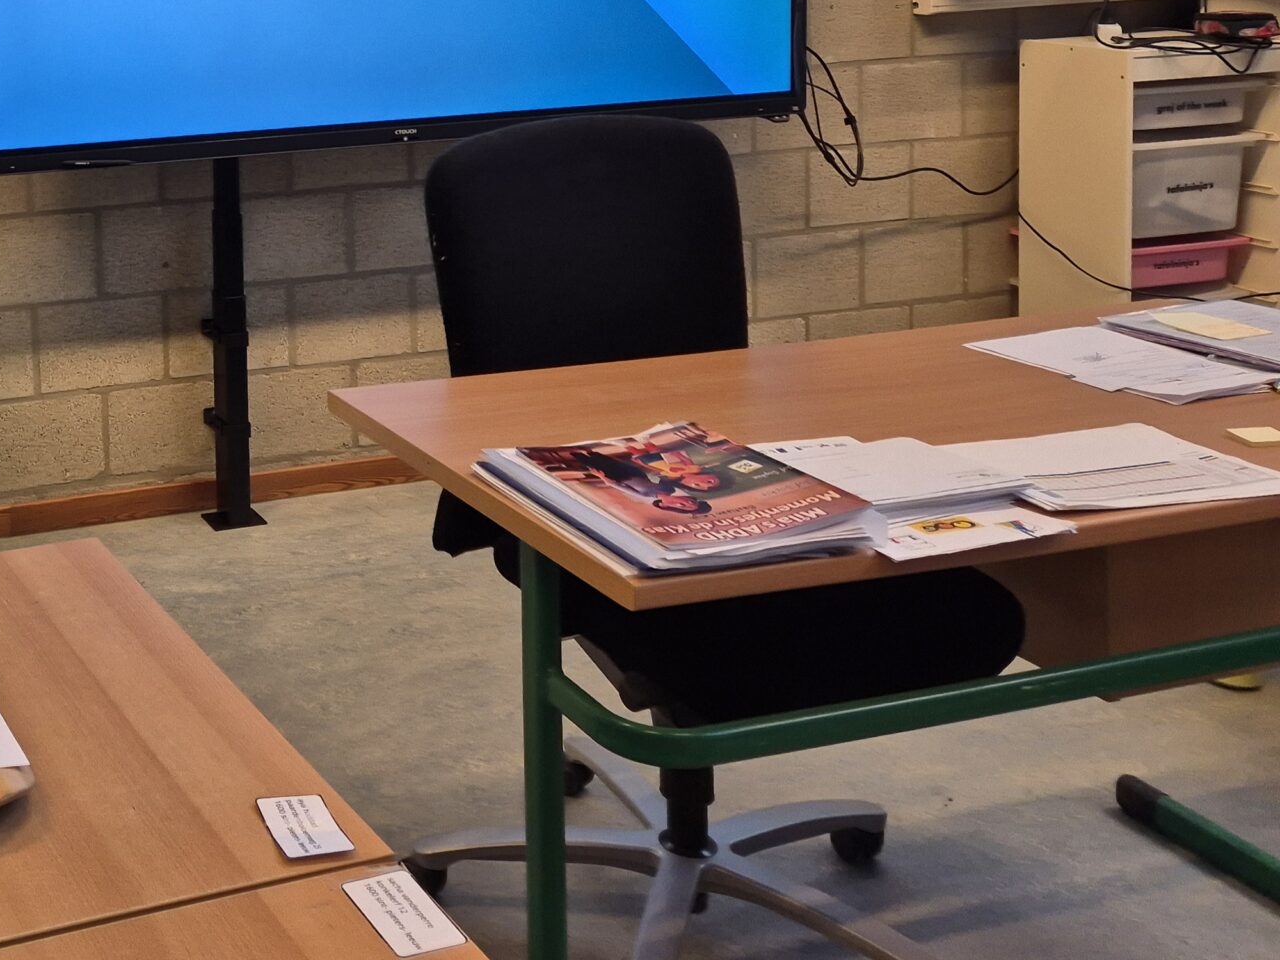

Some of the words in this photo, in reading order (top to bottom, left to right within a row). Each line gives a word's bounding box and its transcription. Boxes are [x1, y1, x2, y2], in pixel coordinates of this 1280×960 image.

[735, 490, 842, 523] Momentjes
[714, 518, 736, 527] in
[762, 506, 828, 530] Mila's
[641, 524, 686, 535] Klas
[688, 521, 713, 531] de
[694, 524, 762, 541] ADHD
[365, 883, 379, 897] 1600
[398, 906, 408, 914] 12
